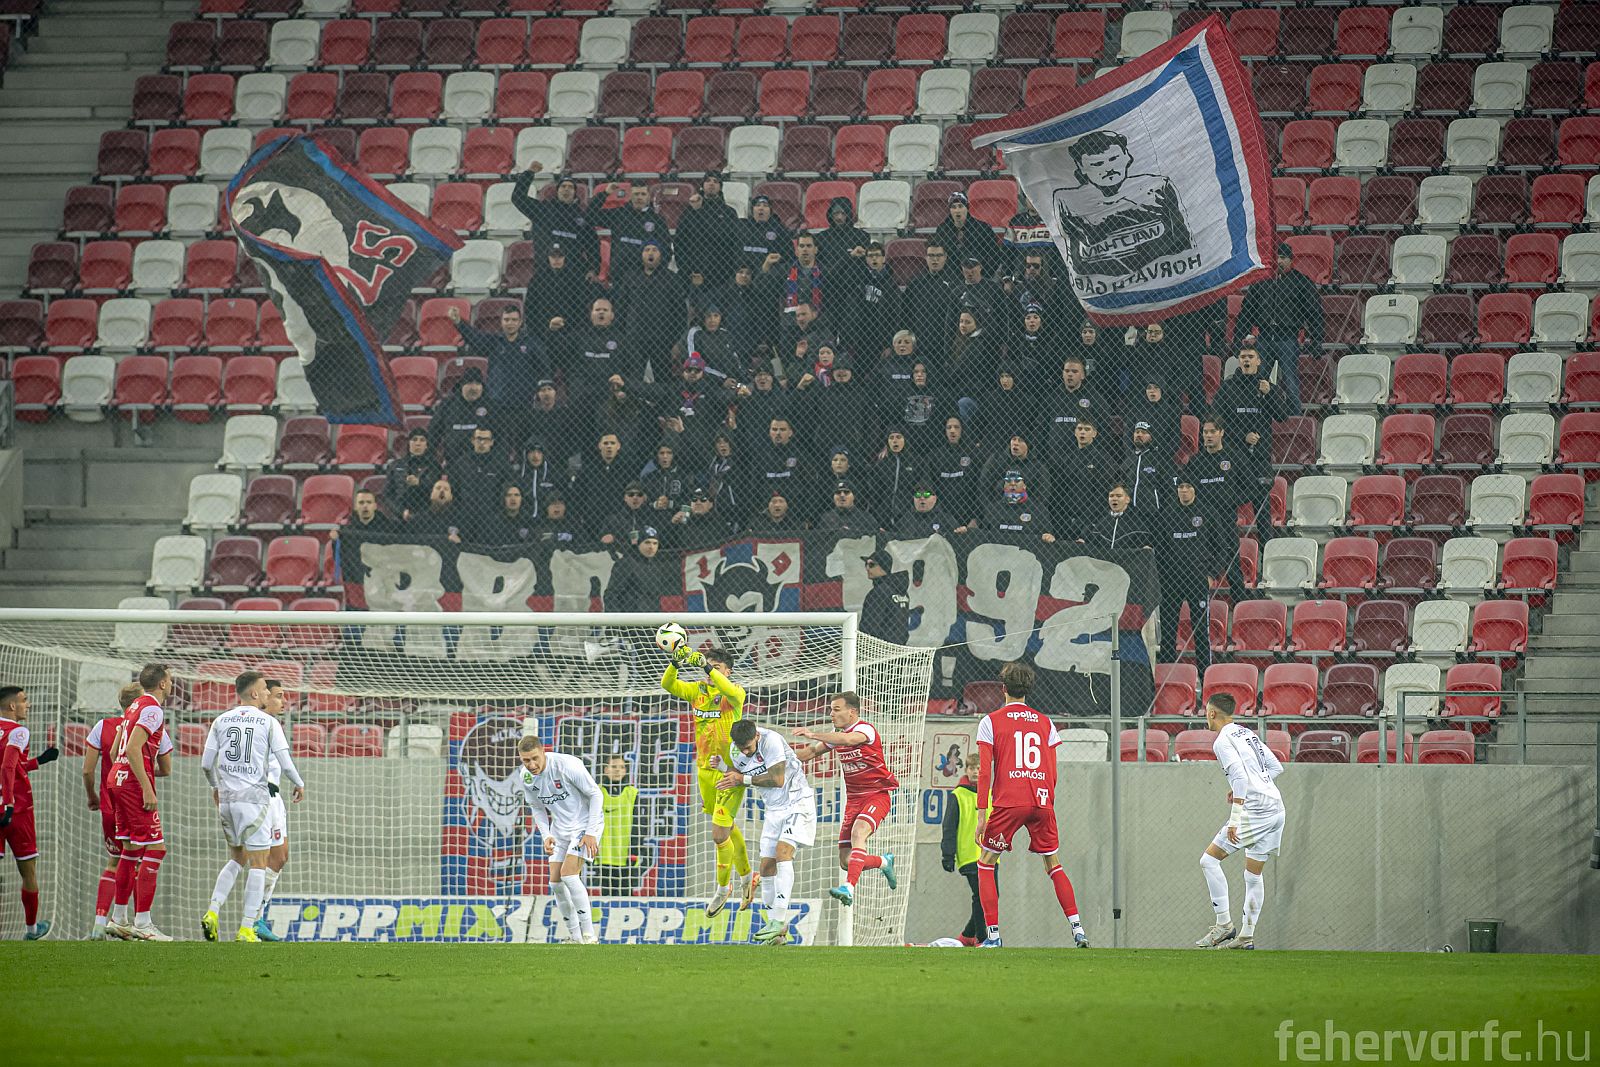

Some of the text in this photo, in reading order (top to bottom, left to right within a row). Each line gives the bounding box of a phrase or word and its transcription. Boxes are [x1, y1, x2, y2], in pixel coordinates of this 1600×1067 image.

[220, 714, 266, 726] FEHÉRVÁR FC
[1006, 710, 1039, 721] apollo
[225, 726, 255, 764] 31
[1013, 730, 1041, 770] 16
[1009, 769, 1046, 781] KOMLÓSI
